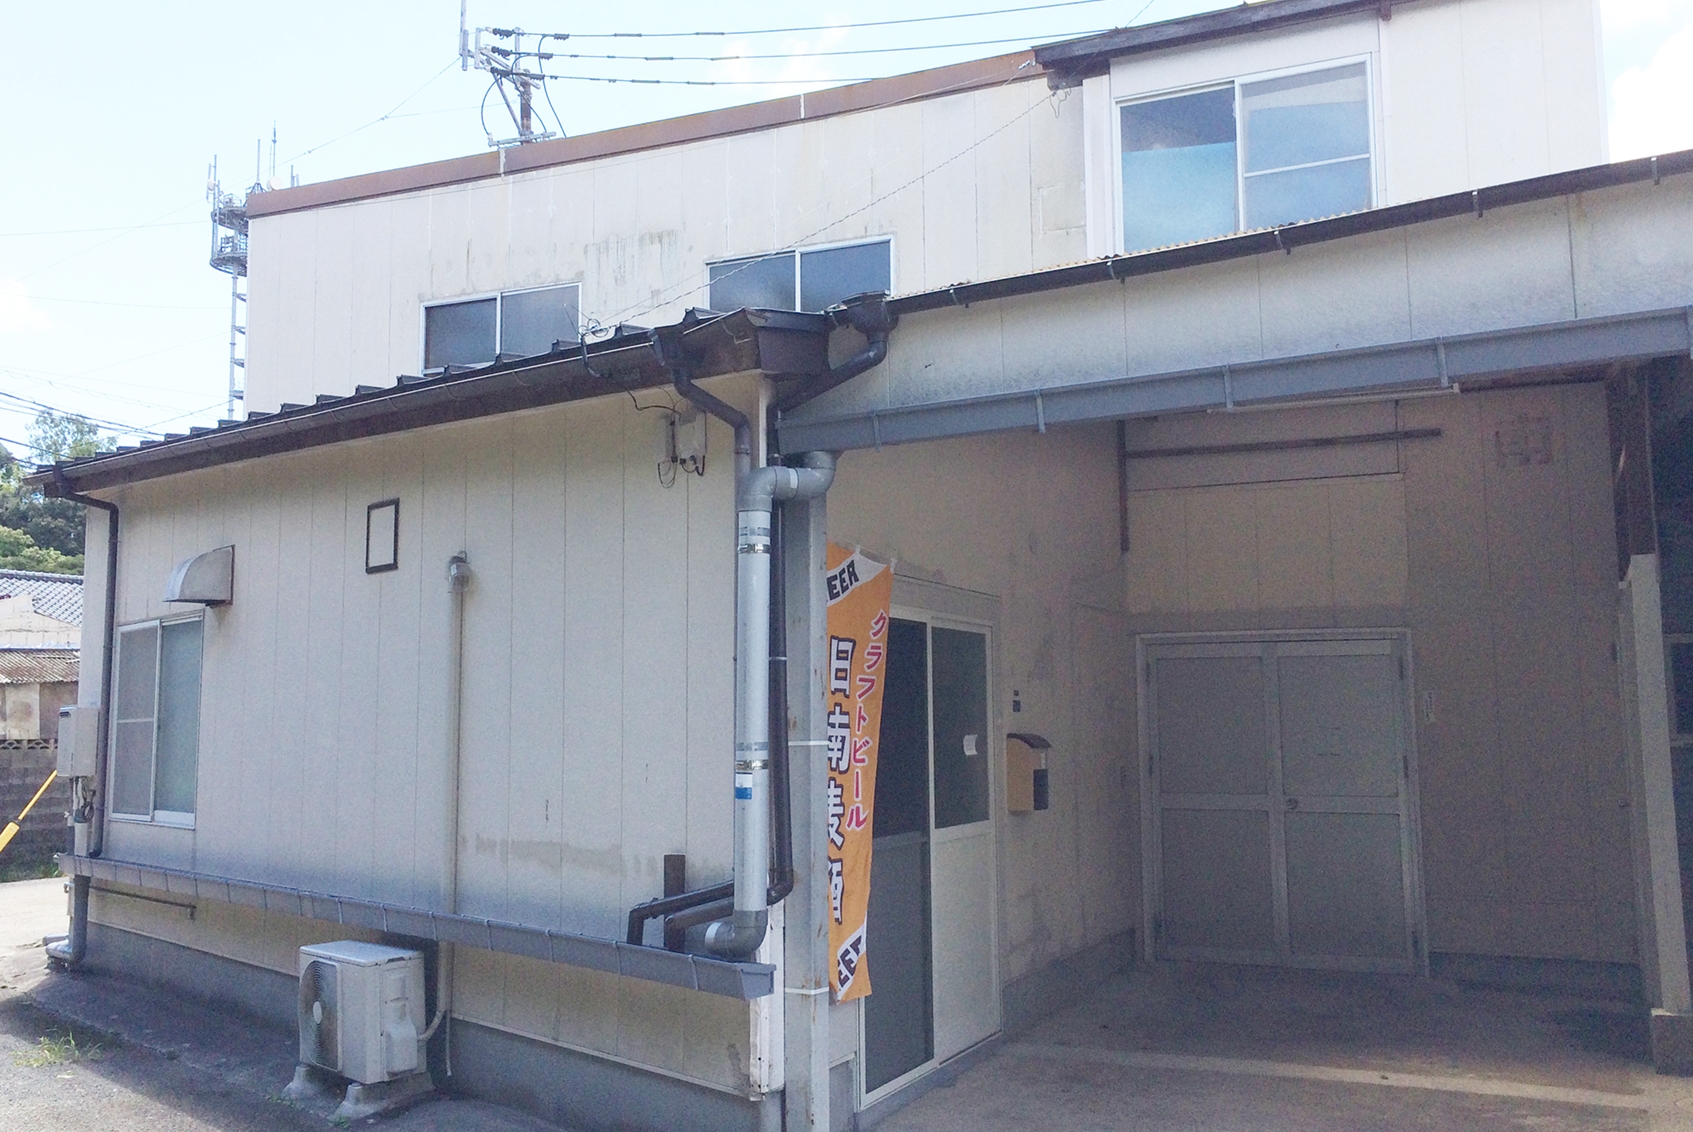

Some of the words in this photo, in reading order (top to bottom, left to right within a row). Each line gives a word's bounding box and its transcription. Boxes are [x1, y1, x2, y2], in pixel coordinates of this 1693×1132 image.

[826, 558, 859, 600] EER
[846, 609, 888, 830] クラフトビール
